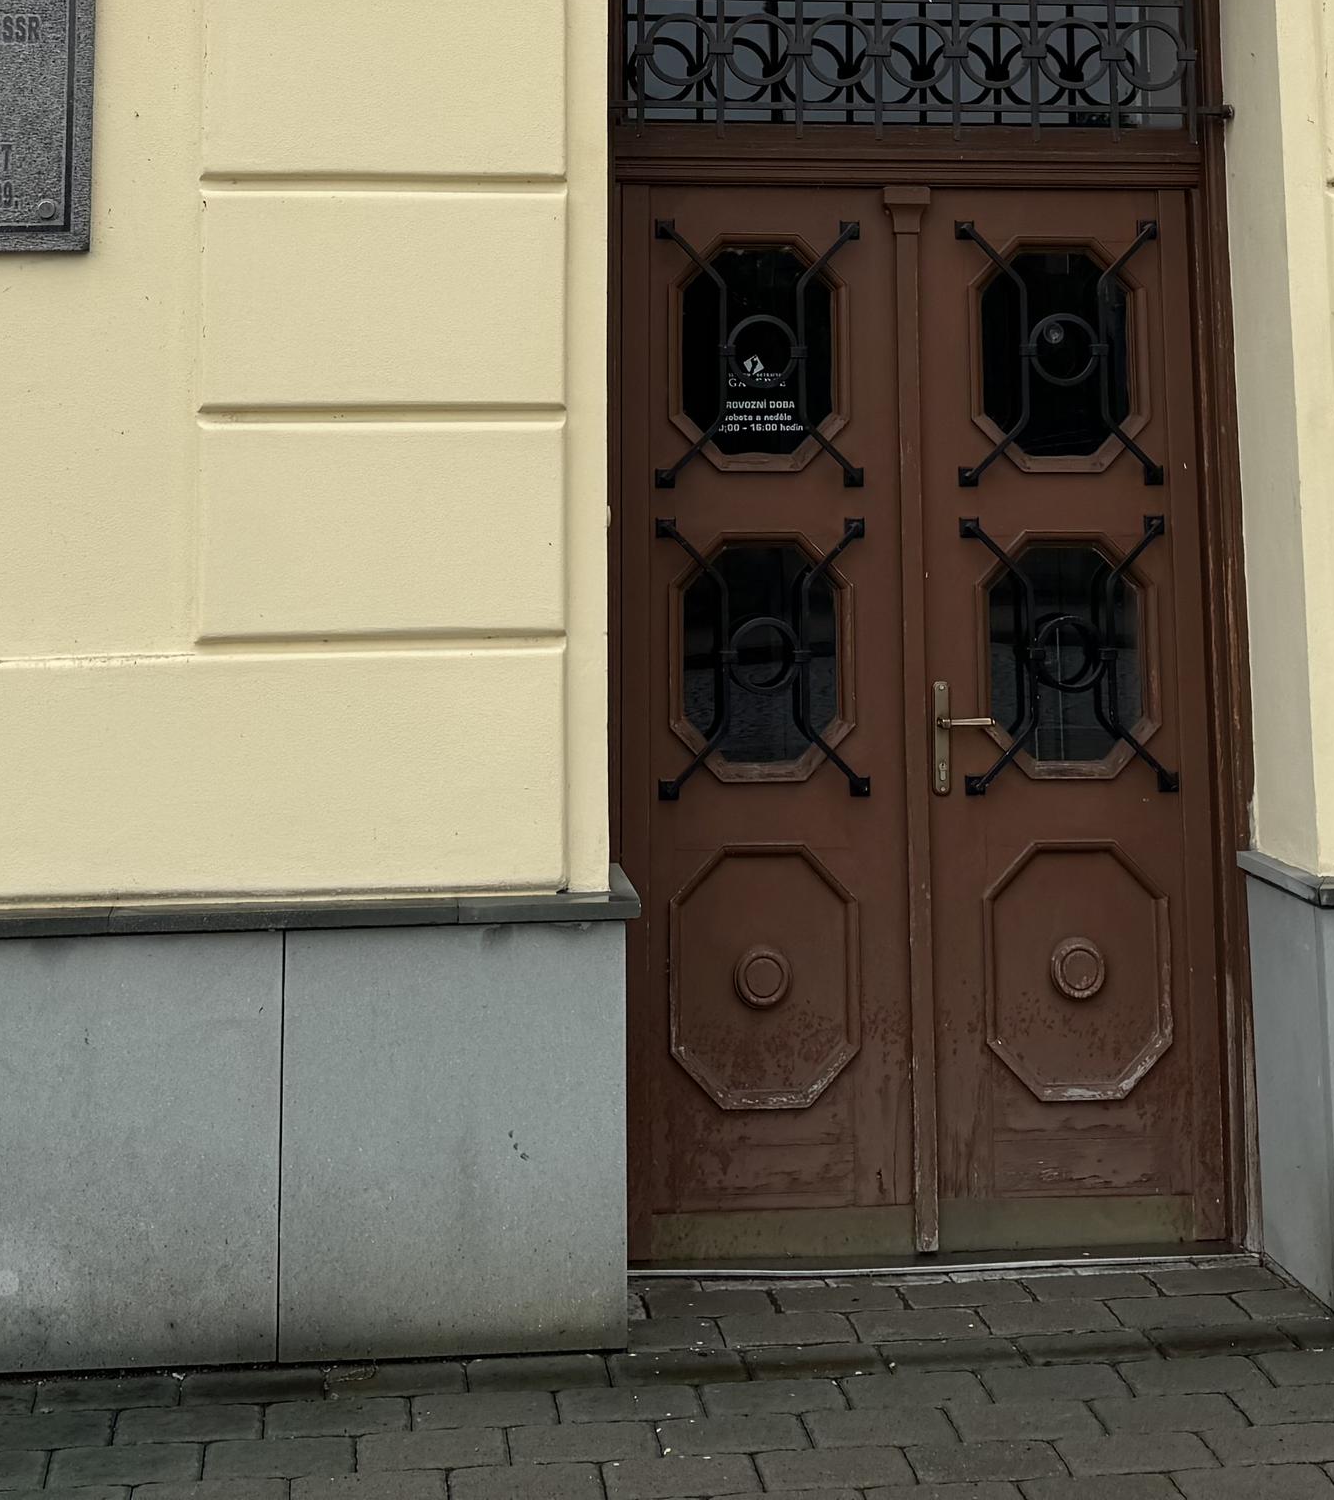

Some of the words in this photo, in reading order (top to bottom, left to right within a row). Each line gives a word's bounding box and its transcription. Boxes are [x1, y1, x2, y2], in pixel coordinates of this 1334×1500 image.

[769, 400, 795, 409] DOBA
[725, 413, 753, 421] obota
[750, 423, 777, 431] 16:00
[780, 423, 803, 431] hodin
